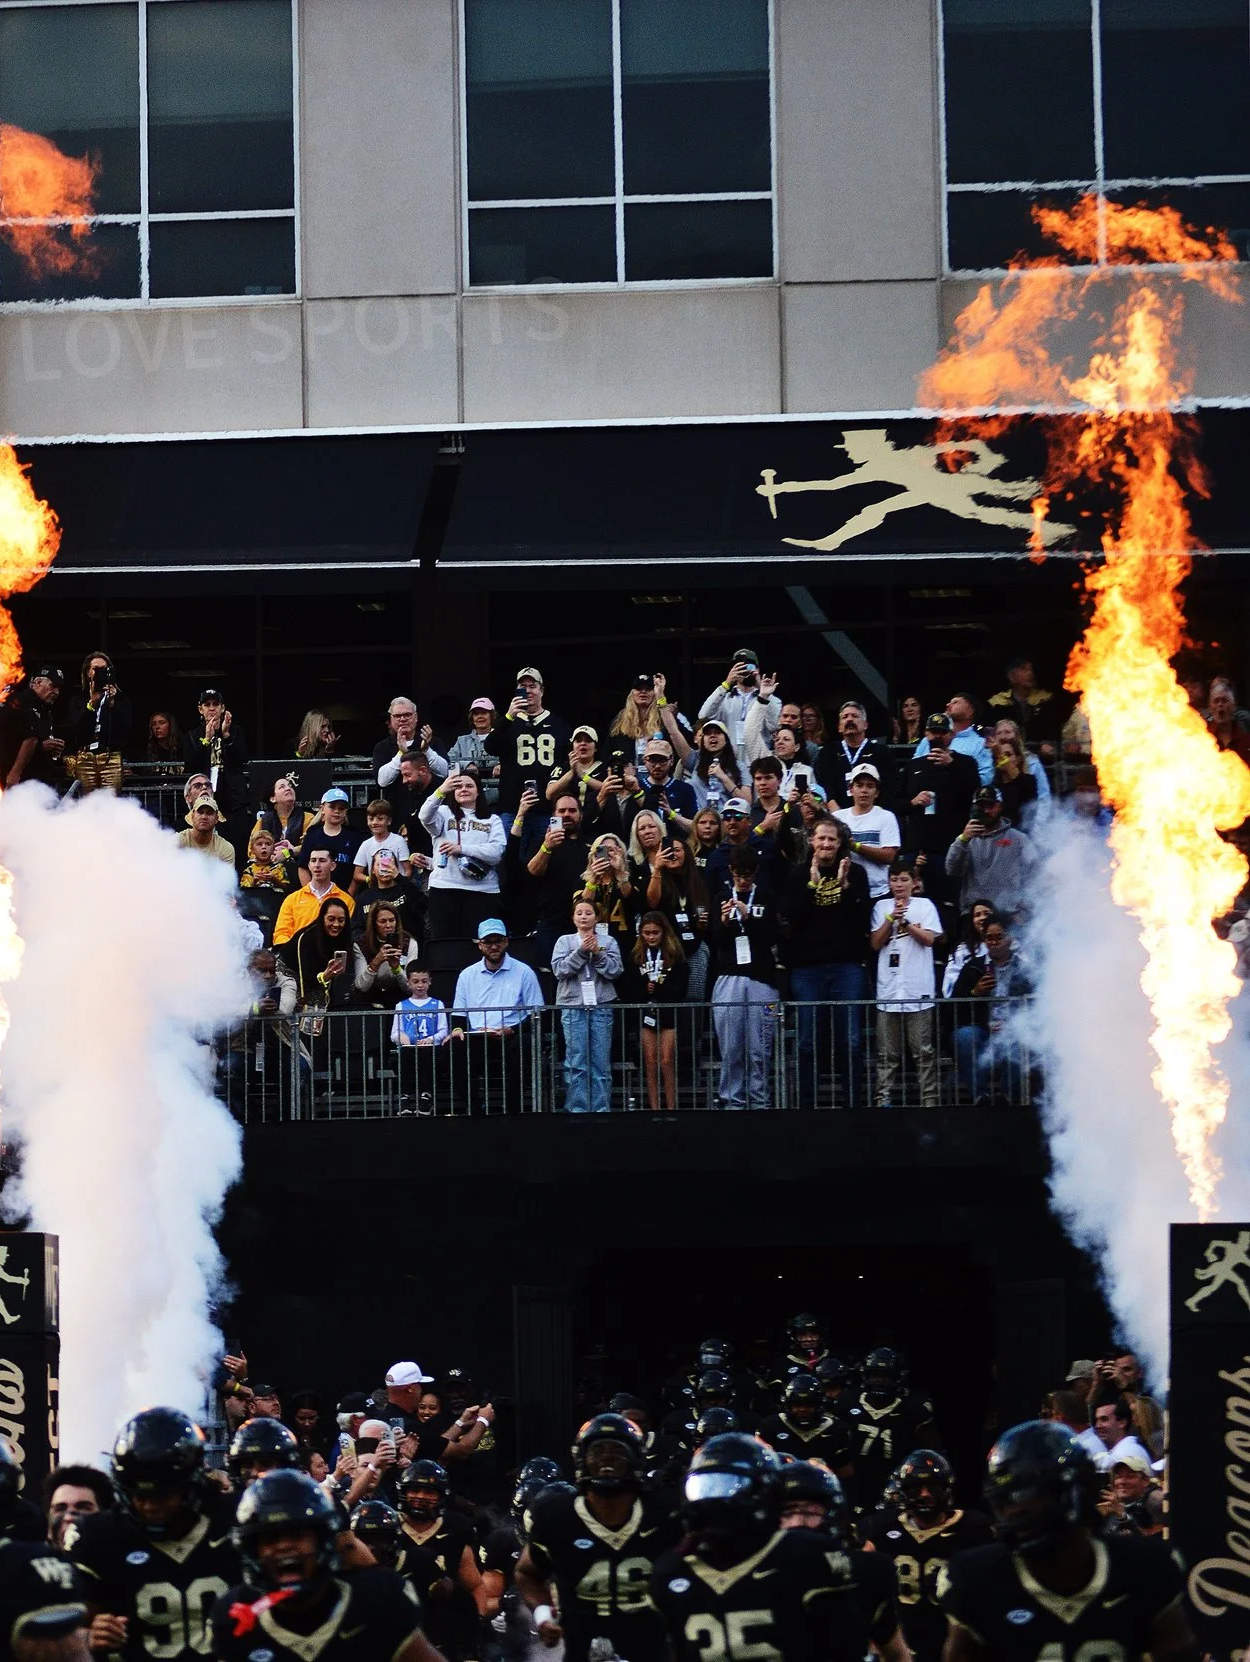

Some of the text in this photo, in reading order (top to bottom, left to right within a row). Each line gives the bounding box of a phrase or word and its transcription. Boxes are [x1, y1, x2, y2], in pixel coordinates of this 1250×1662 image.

[516, 733, 556, 767] 68
[857, 1422, 894, 1460] 71
[575, 1556, 654, 1617] 46
[134, 1575, 231, 1659] 90
